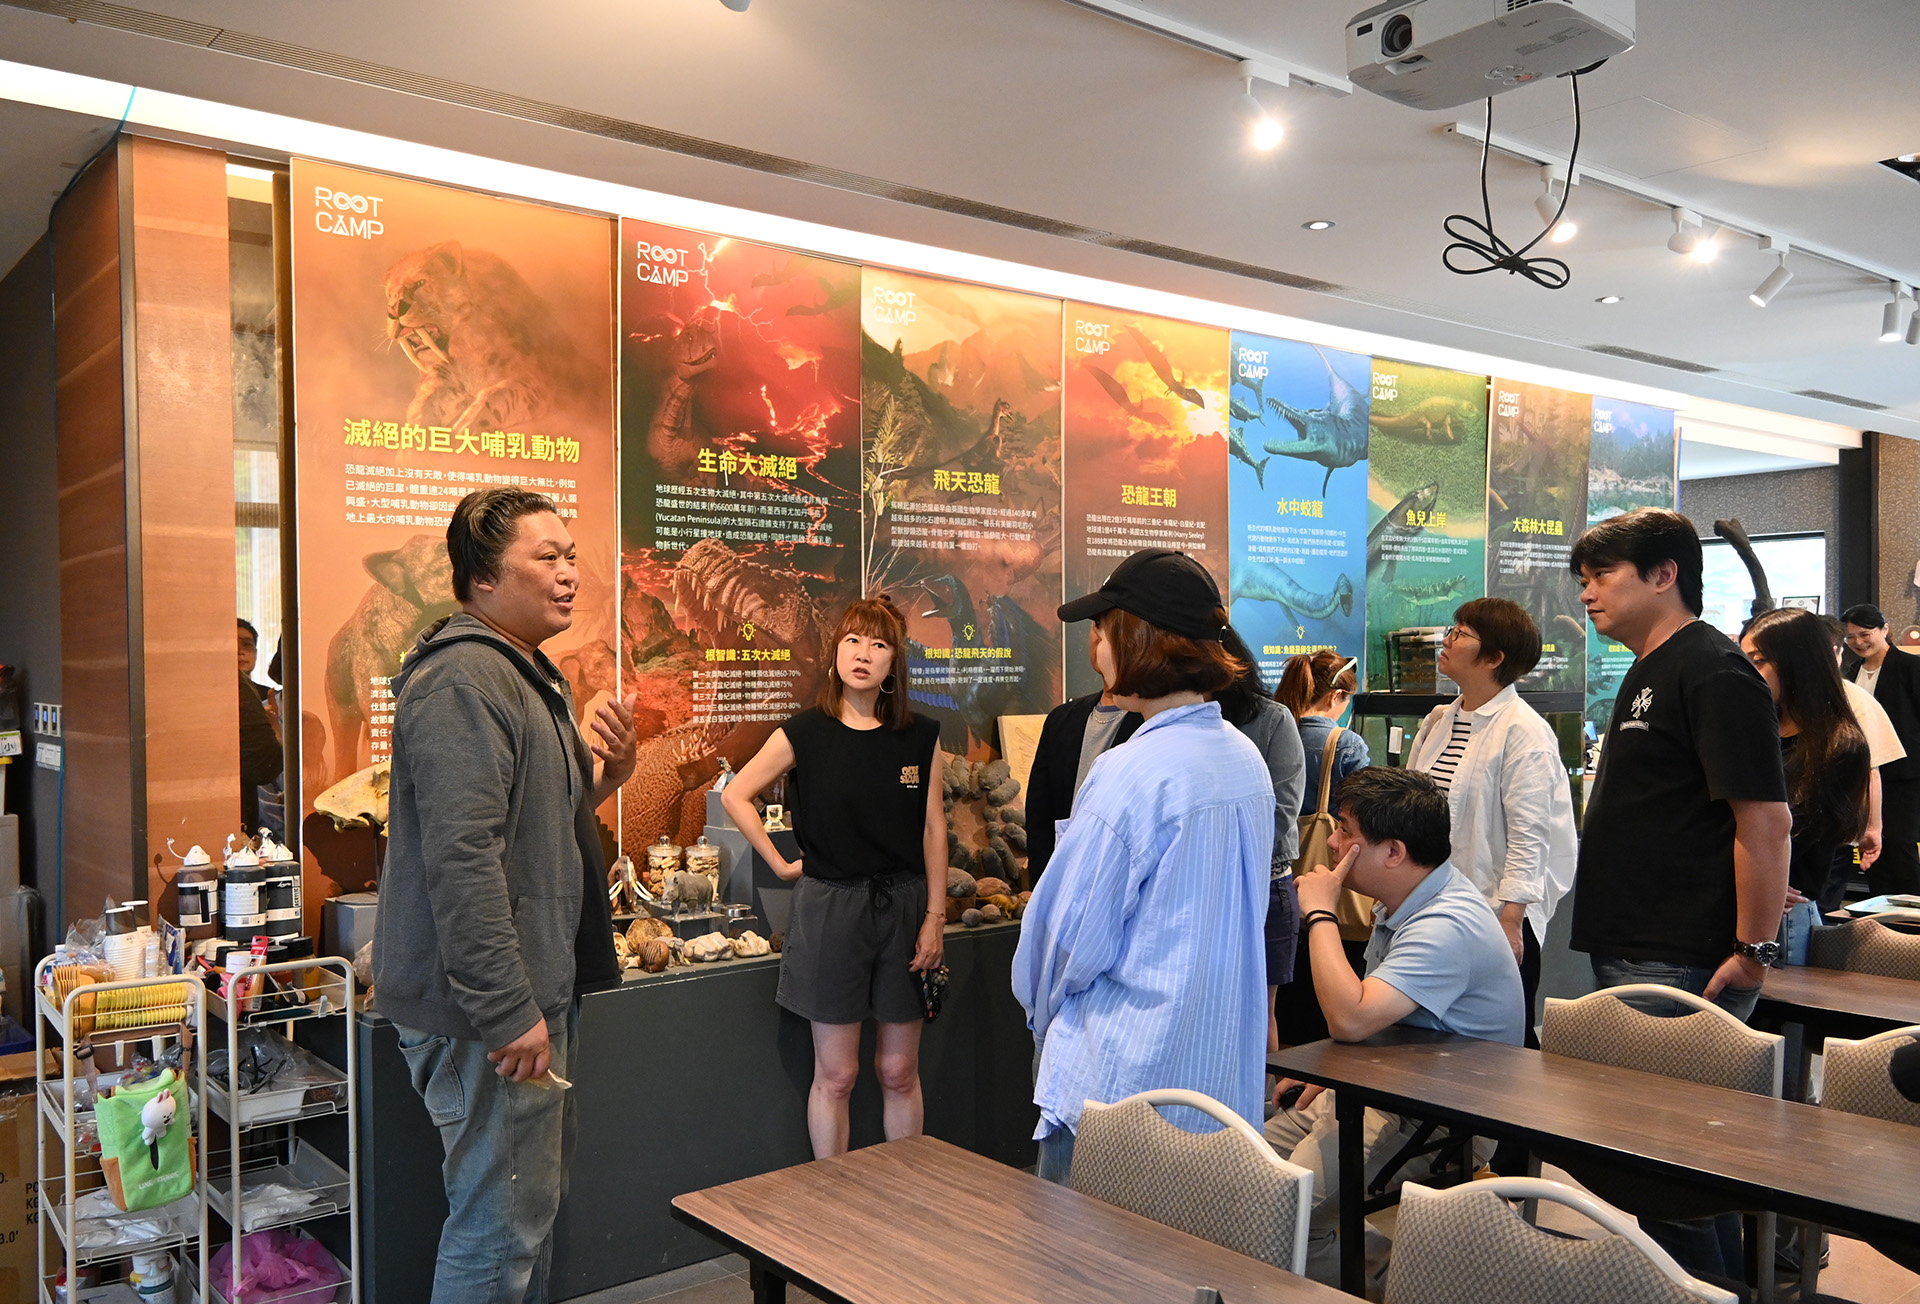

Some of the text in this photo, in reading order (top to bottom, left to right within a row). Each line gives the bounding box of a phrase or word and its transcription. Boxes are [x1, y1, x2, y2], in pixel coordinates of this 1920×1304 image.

[315, 186, 384, 217] ROOT
[315, 211, 384, 240] CAMP
[637, 240, 689, 267] ROOT
[637, 262, 689, 287] CAMP
[873, 287, 916, 308] ROOT
[873, 305, 916, 326] CAMP
[1075, 319, 1110, 339] ROOT
[1075, 336, 1110, 355] CAMP
[1238, 347, 1269, 365] ROOT
[1238, 363, 1269, 380] CAMP
[1372, 372, 1398, 388] ROOT
[1372, 386, 1398, 401] CAMP
[1498, 390, 1520, 405] ROOT
[343, 417, 580, 463] 滅絕的巨大哺乳動物
[697, 447, 798, 480] 生命大滅絕
[933, 469, 1001, 495] 飛天恐龍
[1121, 484, 1177, 508] 恐龍王朝
[655, 512, 686, 523] (Yucatan
[1277, 497, 1324, 518] 水中蛟龍
[1406, 509, 1447, 528] 魚兒上岸
[1512, 517, 1563, 536] 大森林大昆蟲
